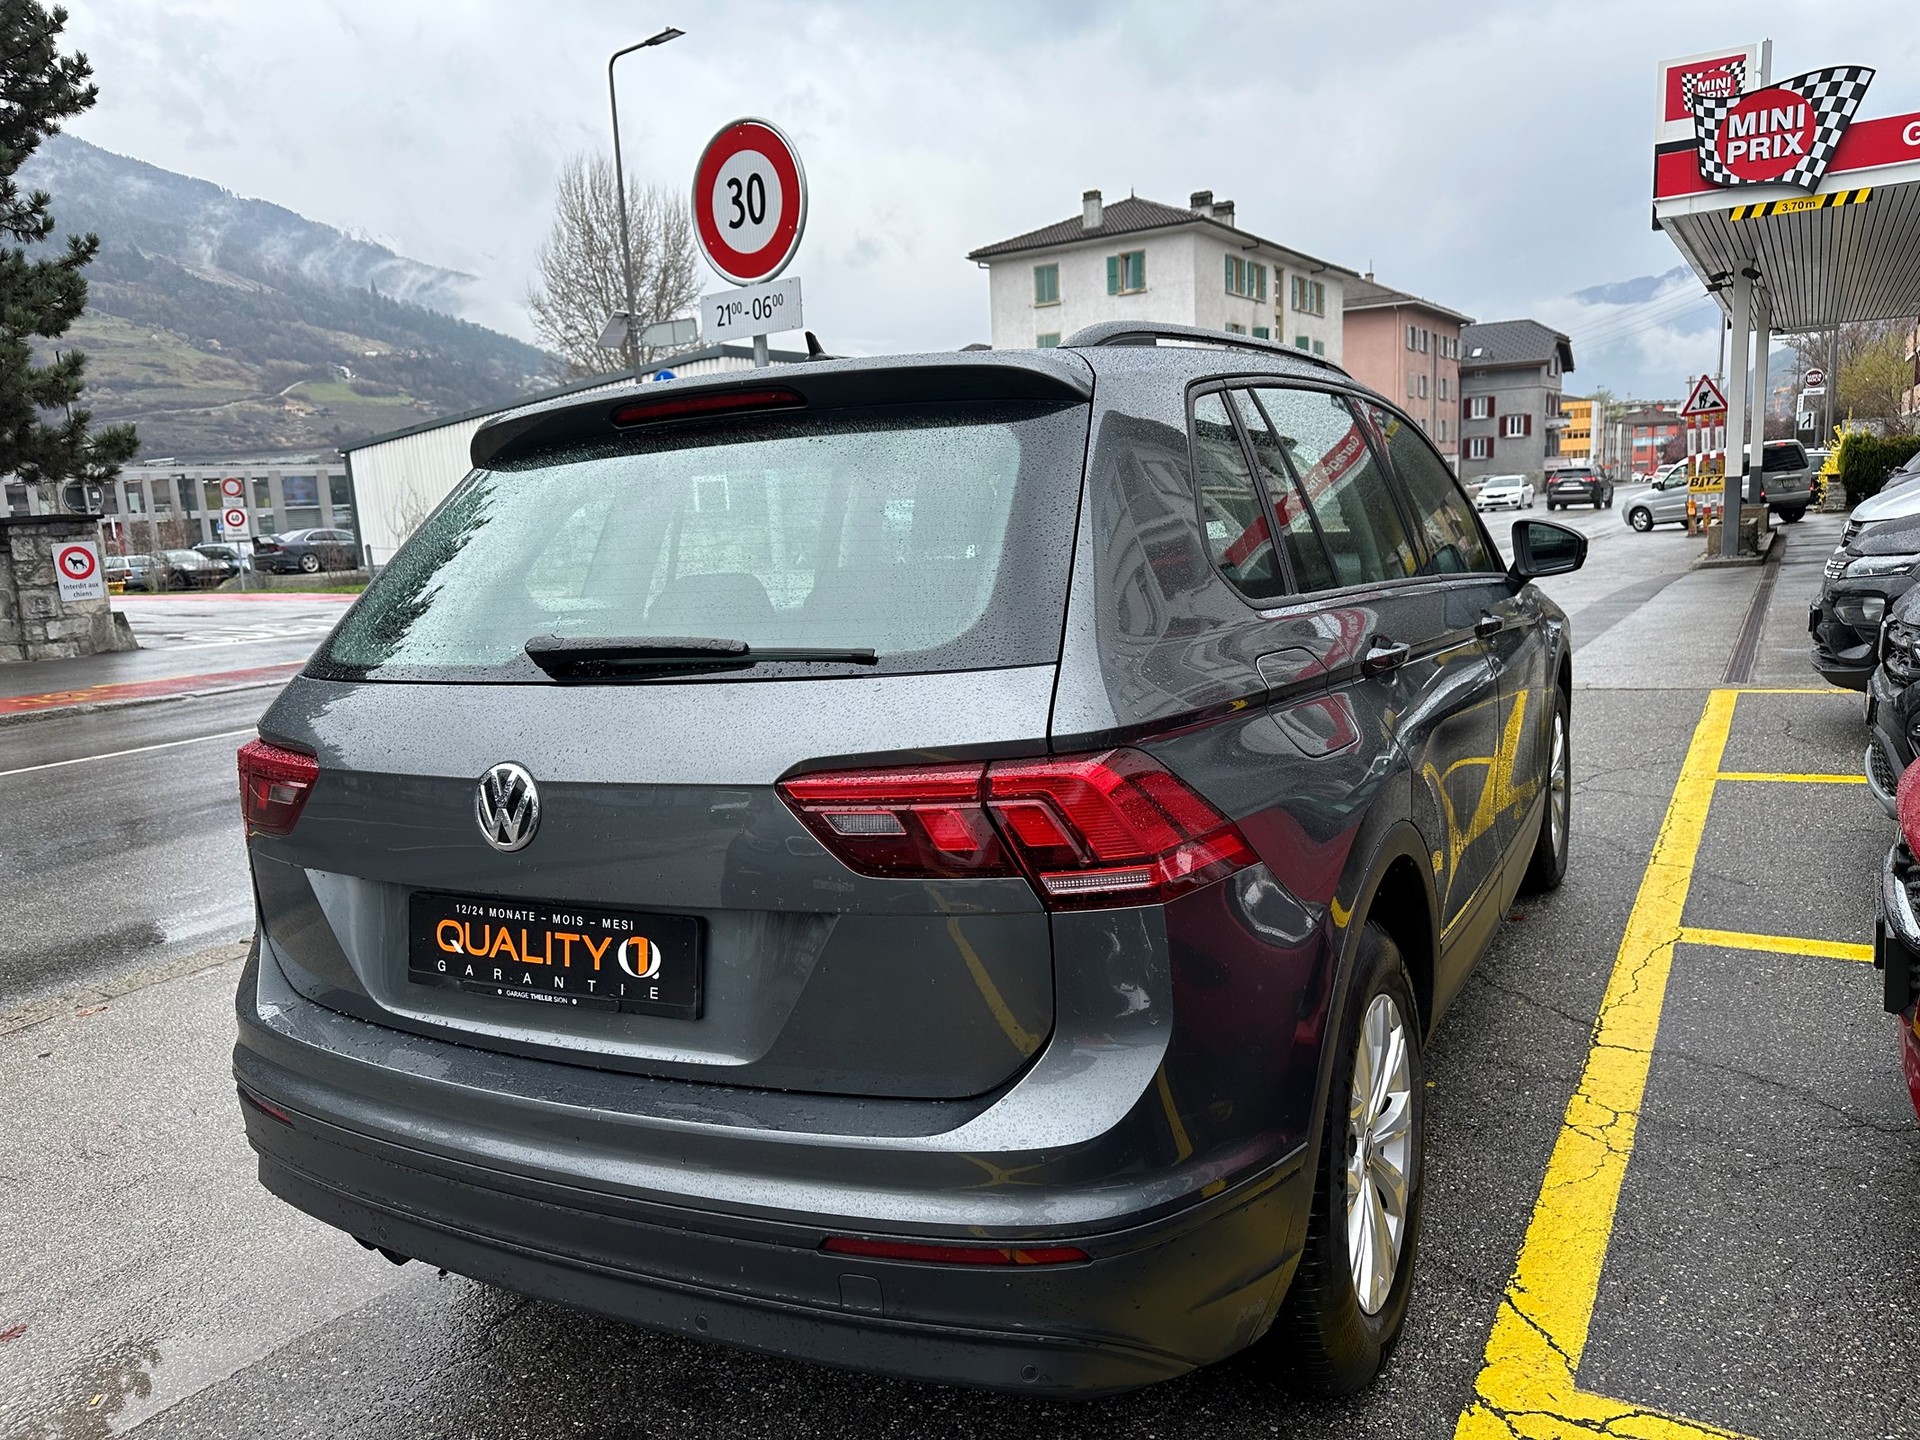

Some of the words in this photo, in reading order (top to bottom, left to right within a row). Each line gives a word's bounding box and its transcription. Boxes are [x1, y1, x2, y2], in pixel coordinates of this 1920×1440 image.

[1697, 76, 1731, 93] MINI
[1727, 103, 1806, 139] MINI
[1902, 120, 1920, 146] G
[1726, 131, 1805, 165] PRIX
[726, 172, 766, 229] 30
[455, 903, 484, 916] 12/24
[489, 907, 536, 922] MONATE
[552, 914, 584, 926] MOIS
[602, 918, 634, 931] MESI
[436, 919, 612, 971] QUALITY
[505, 989, 529, 999] GARAGE
[530, 993, 553, 1002] THELER
[553, 996, 568, 1004] SION
